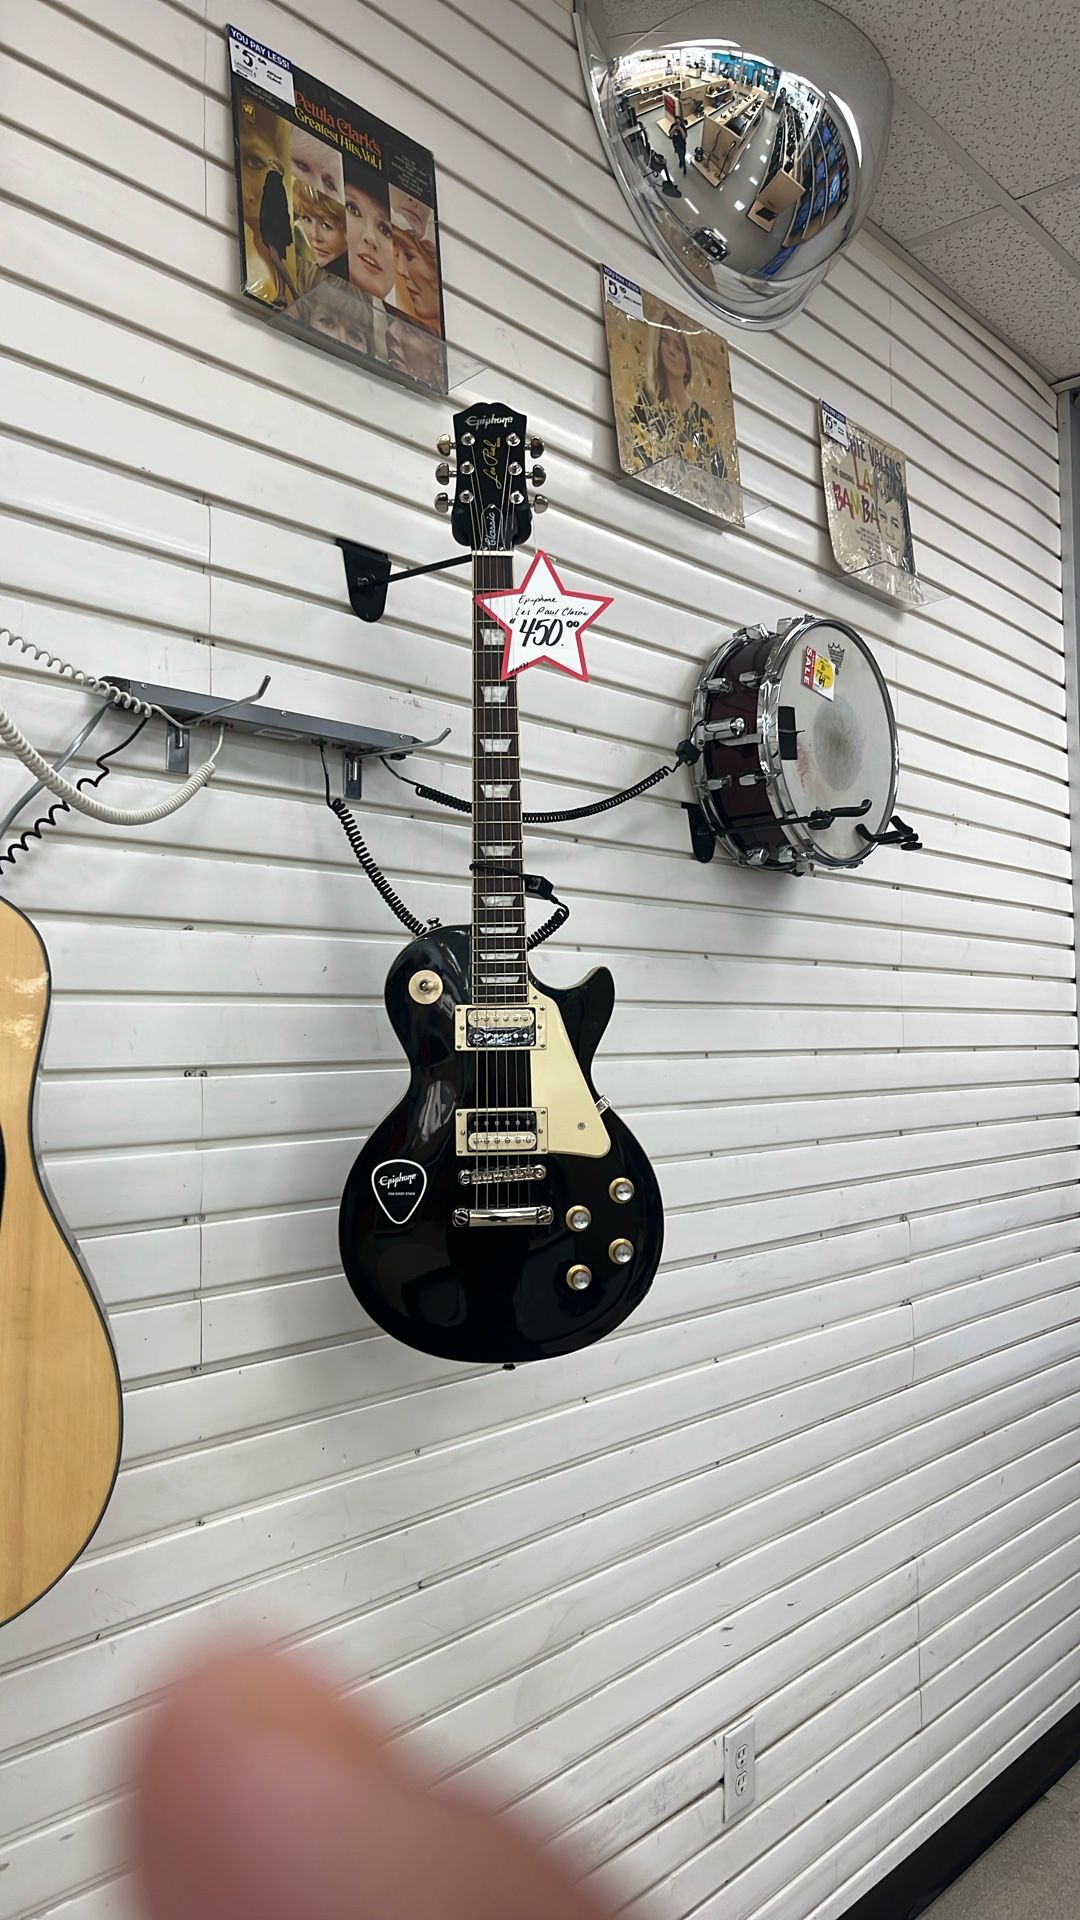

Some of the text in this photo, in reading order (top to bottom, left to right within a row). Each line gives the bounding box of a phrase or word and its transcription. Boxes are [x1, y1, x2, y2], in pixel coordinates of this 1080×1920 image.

[230, 27, 249, 45] YOU
[249, 41, 266, 56] PAY
[267, 50, 290, 70] LESS!
[294, 89, 336, 128] Petula
[337, 118, 382, 157] Clark's
[294, 107, 339, 145] Greatest
[464, 413, 513, 430] Epiphone
[482, 439, 502, 490] Les Paul
[832, 481, 882, 533] BAMBA
[484, 511, 496, 546] Classic
[515, 606, 531, 616] Les
[536, 606, 560, 616] Paul
[803, 647, 813, 686] SALE
[378, 1172, 417, 1189] Epiphone
